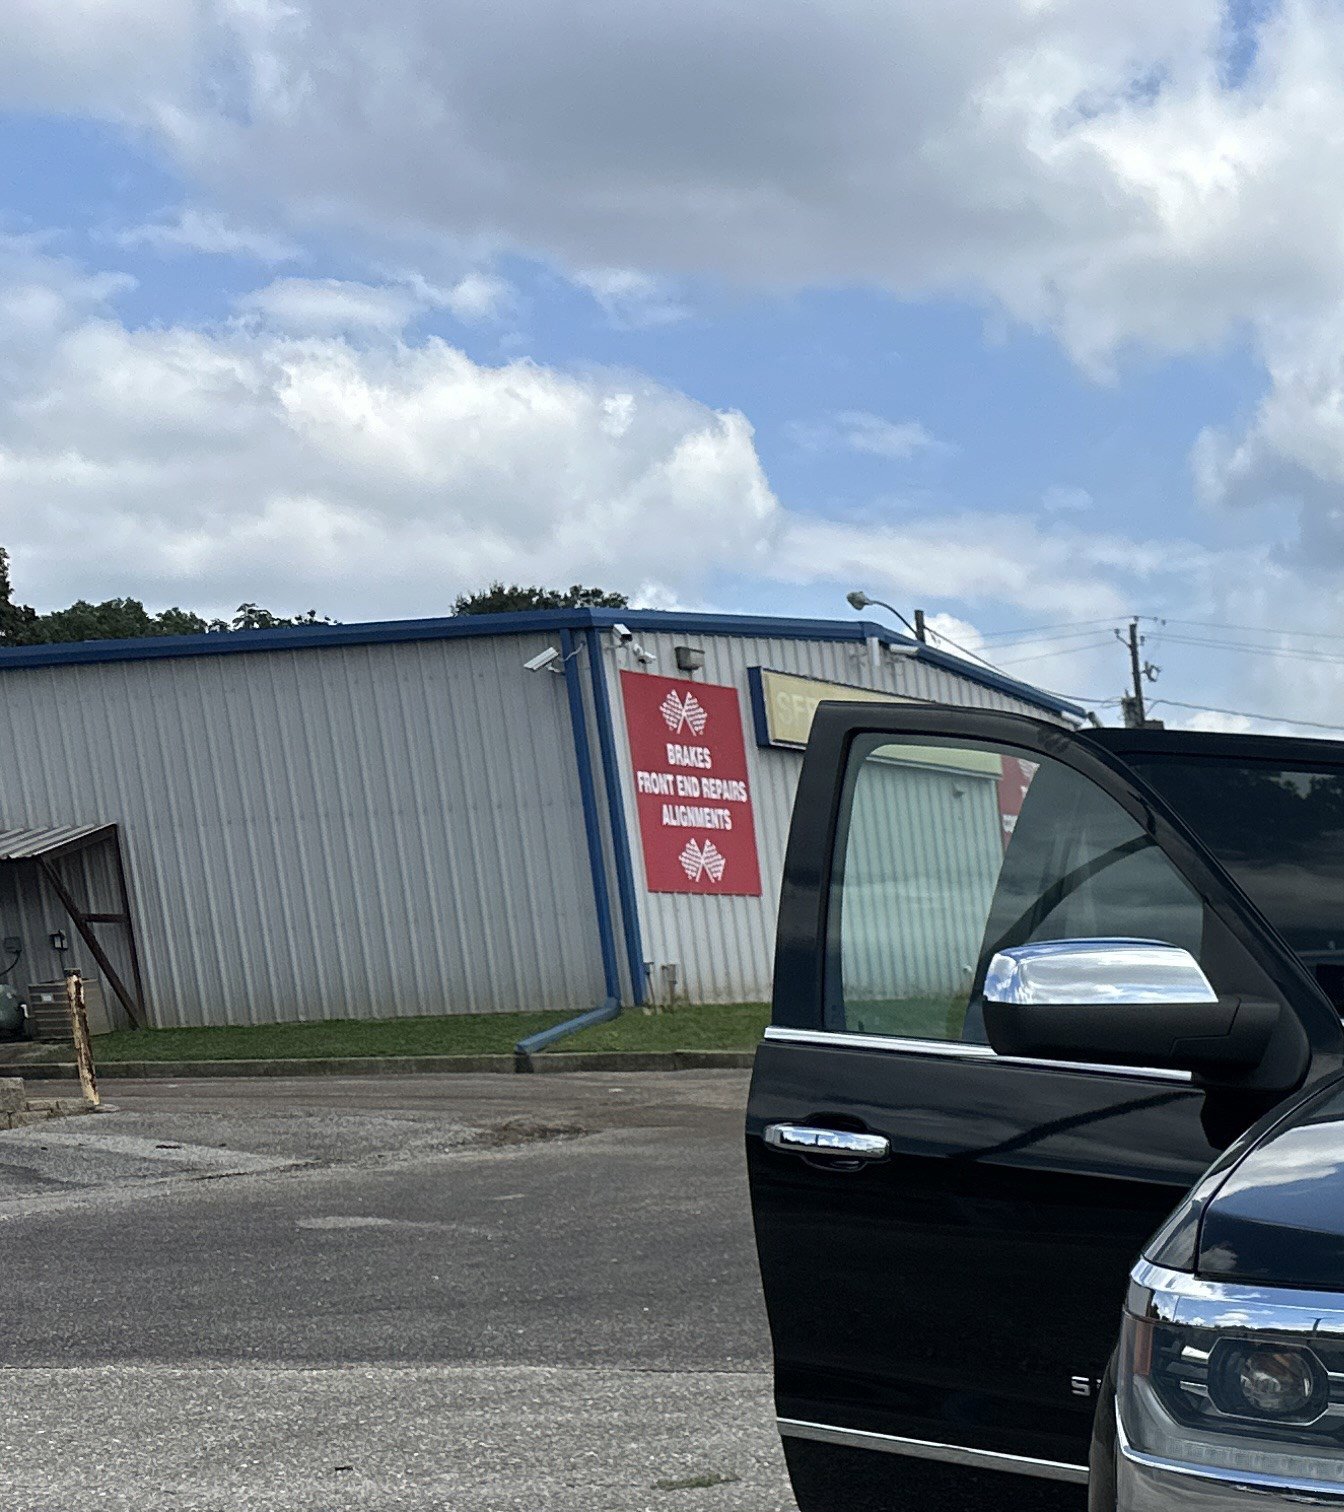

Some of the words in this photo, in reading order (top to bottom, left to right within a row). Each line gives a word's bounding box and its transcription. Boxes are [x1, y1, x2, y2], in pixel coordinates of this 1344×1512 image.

[666, 743, 711, 769] BRAKES
[637, 771, 675, 795] FRONT
[676, 775, 700, 798] END
[701, 777, 747, 802] REPAIRS
[662, 804, 732, 830] ALIGNMENTS
